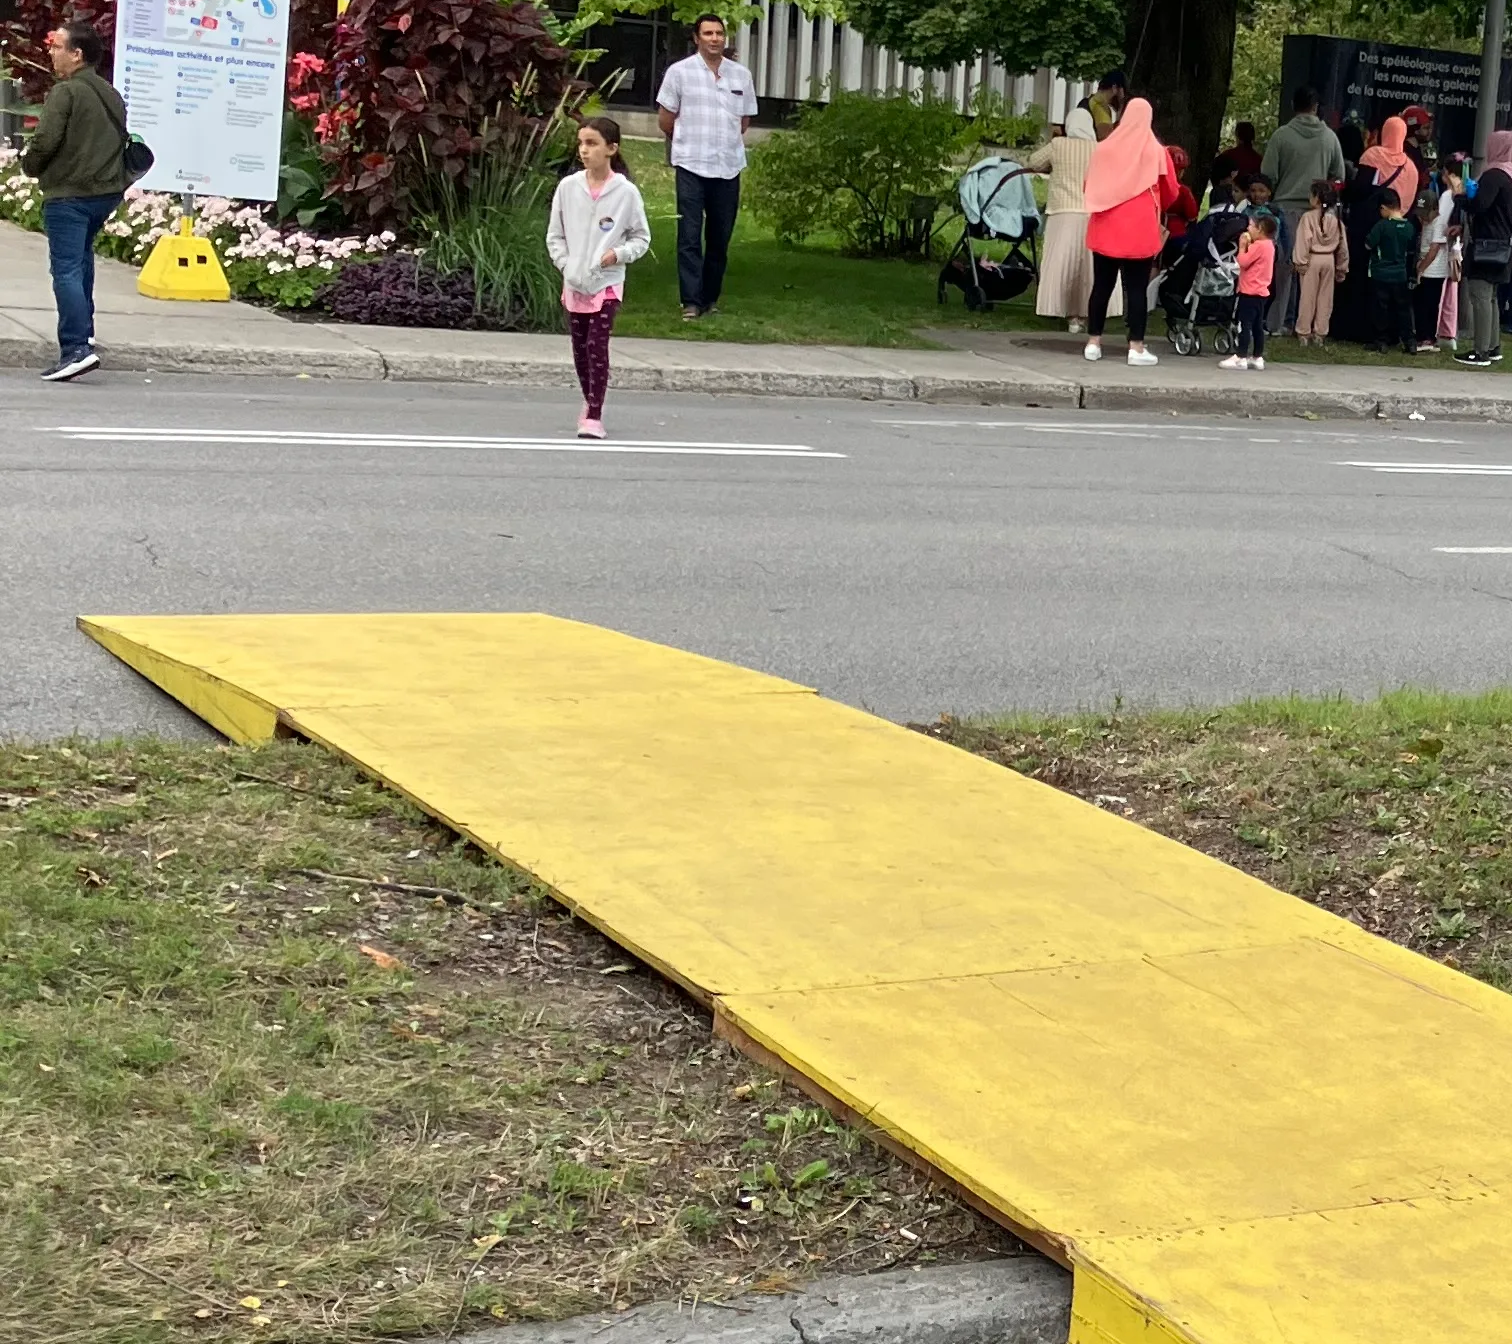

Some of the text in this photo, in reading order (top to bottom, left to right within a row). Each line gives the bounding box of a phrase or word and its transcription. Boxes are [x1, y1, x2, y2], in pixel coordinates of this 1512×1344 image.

[1359, 51, 1481, 77] Des spéléologues explo
[1374, 70, 1479, 93] les nouvelles galerie
[1347, 83, 1361, 95] de
[1364, 84, 1374, 97] la
[1377, 88, 1419, 102] caverne
[1422, 92, 1435, 104] de
